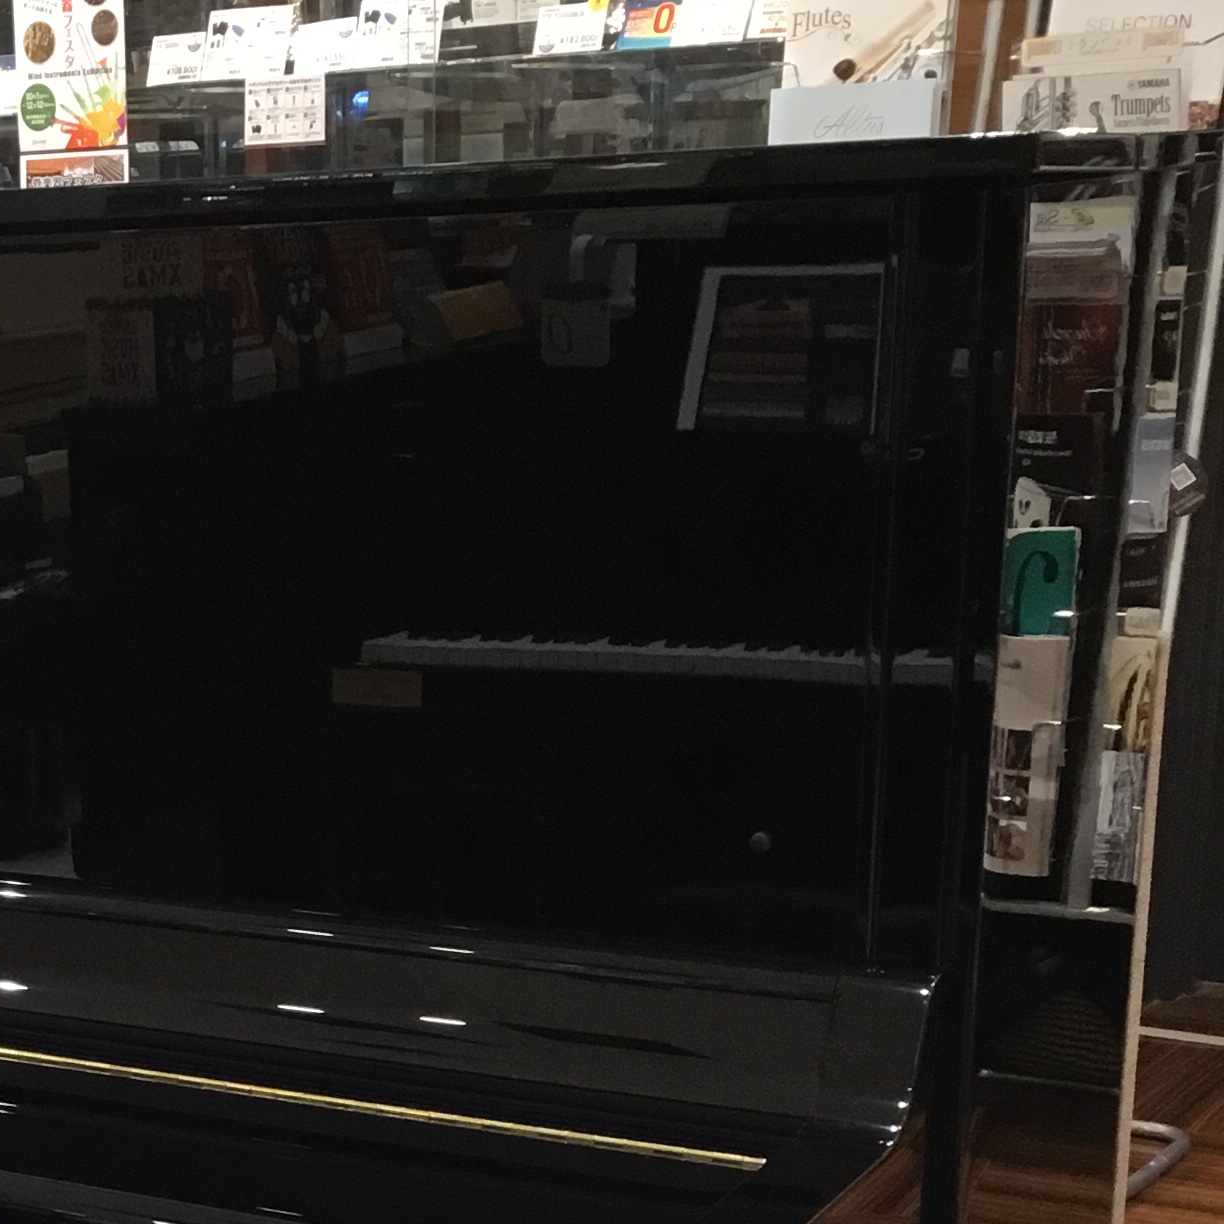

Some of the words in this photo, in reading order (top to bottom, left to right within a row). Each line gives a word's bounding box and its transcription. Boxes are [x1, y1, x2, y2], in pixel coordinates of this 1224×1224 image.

[792, 6, 852, 38] Flutes
[1086, 13, 1193, 33] SELECTION
[1137, 78, 1170, 89] YAMAHA
[1111, 93, 1171, 116] Trumpets
